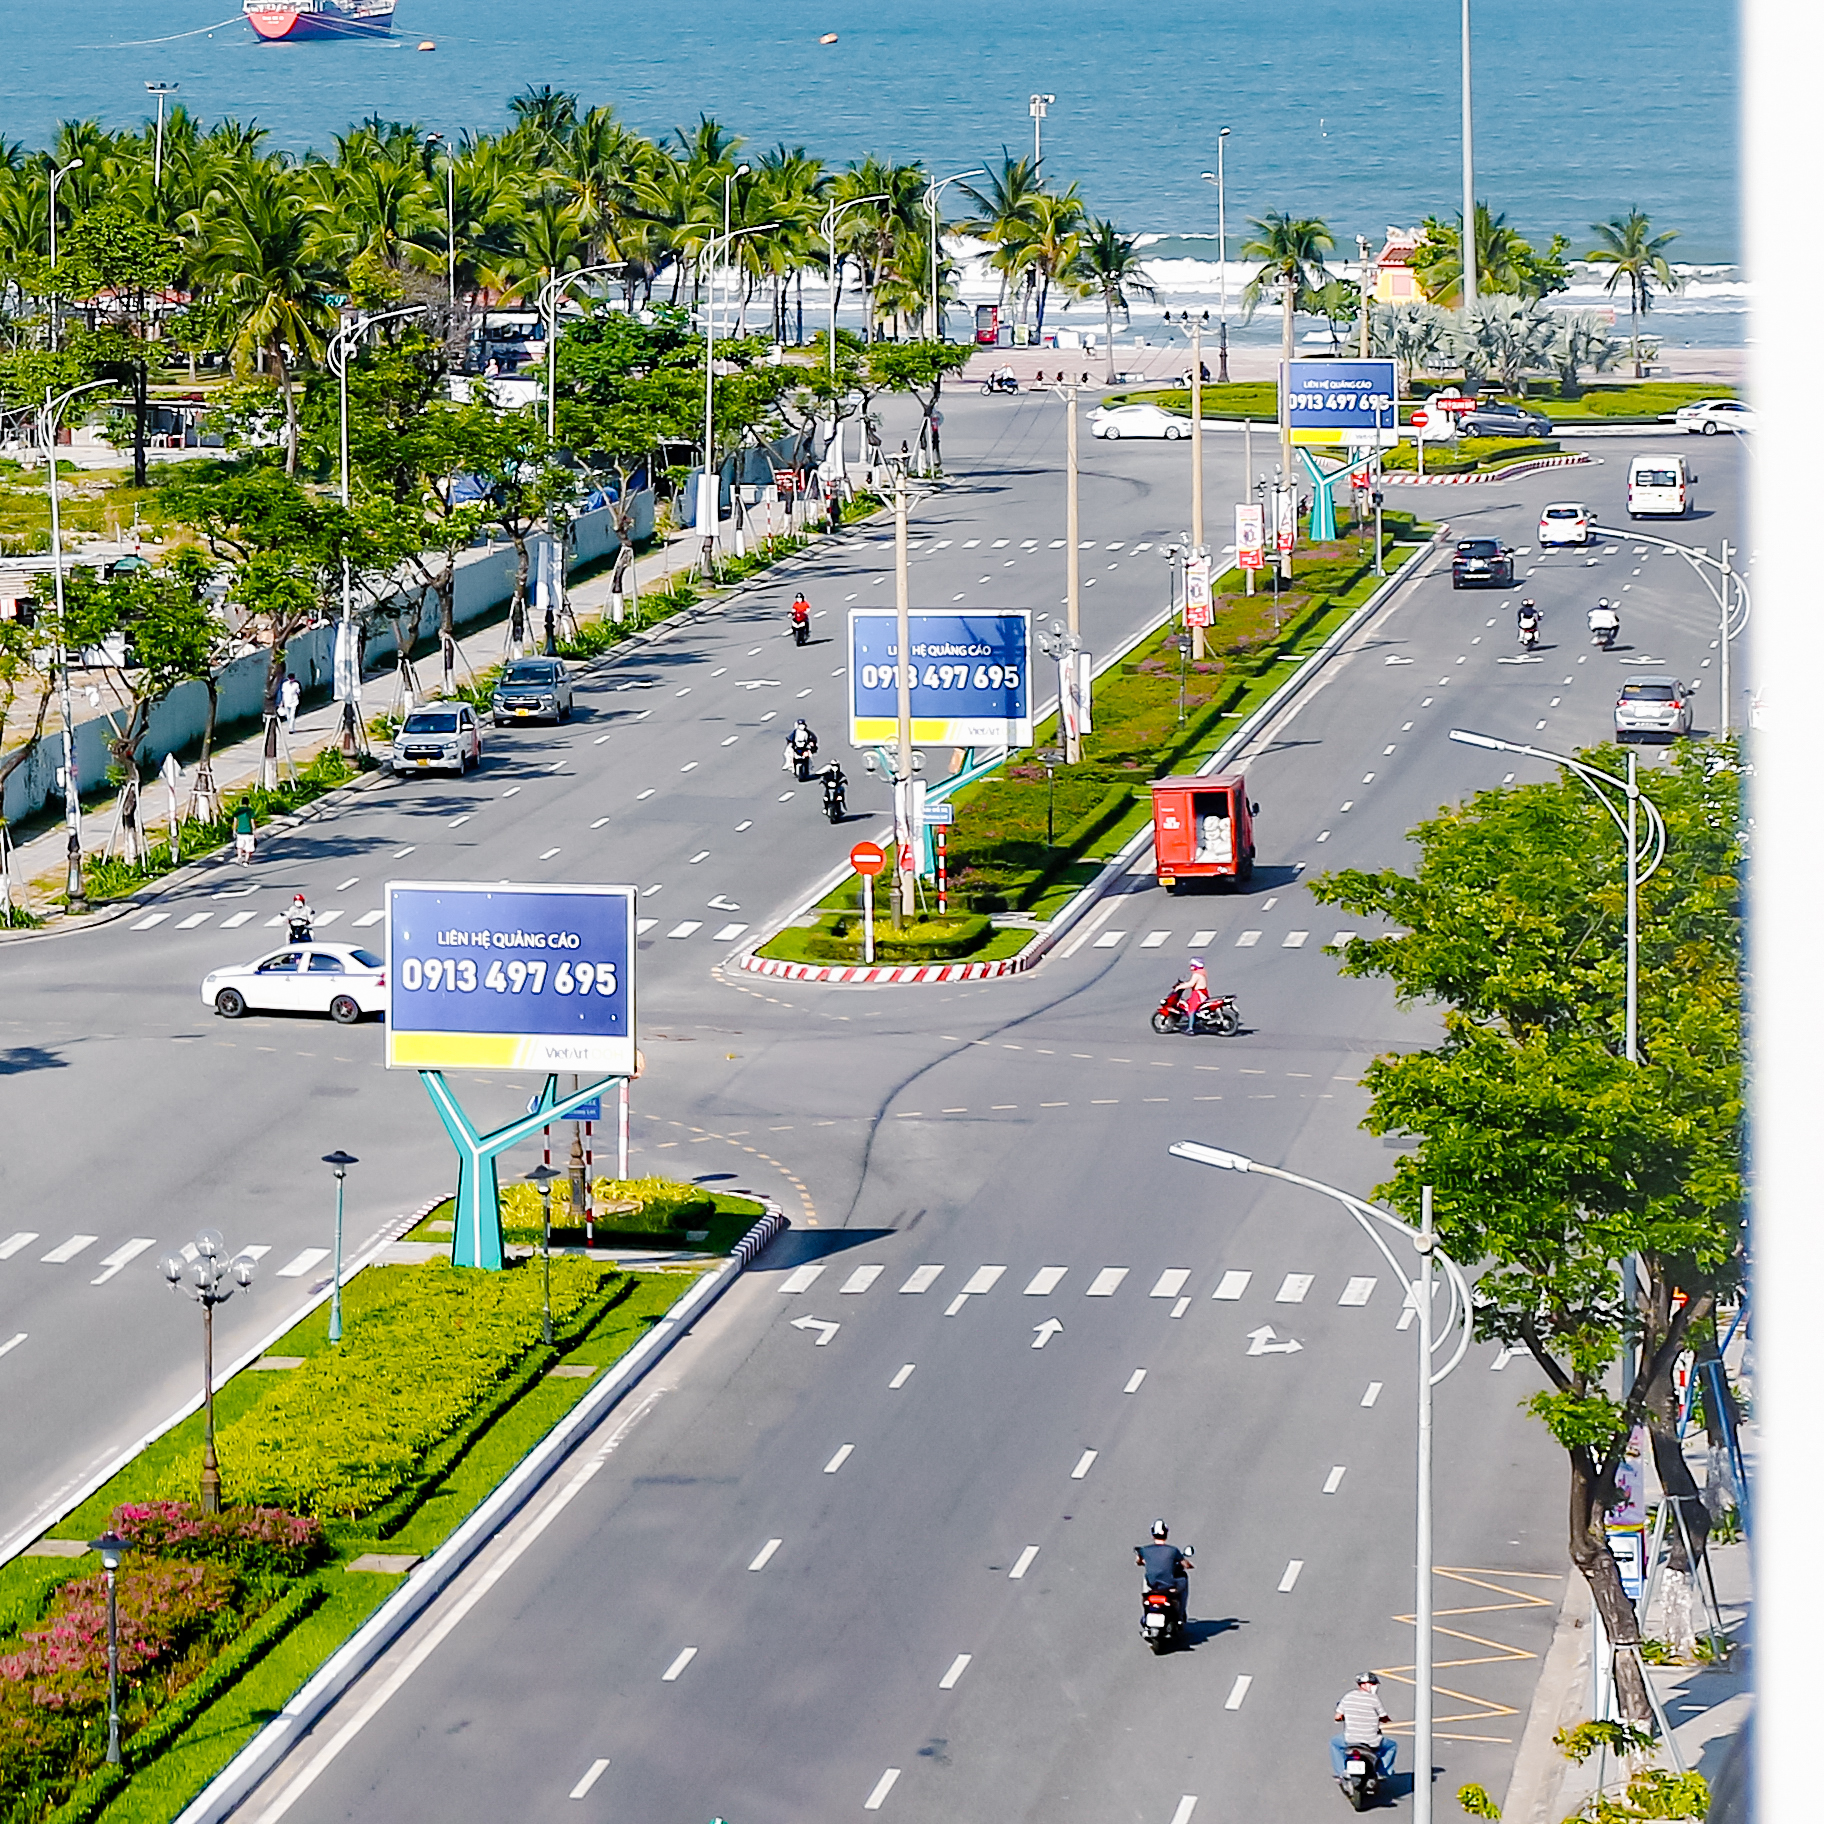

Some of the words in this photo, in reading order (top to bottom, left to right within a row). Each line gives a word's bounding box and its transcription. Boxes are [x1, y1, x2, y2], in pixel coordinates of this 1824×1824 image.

[1289, 393, 1324, 411] 0913
[1325, 393, 1358, 411] 497
[911, 642, 927, 658] HỆ
[927, 641, 968, 657] QUẢNG
[967, 643, 992, 657] CÁO
[922, 663, 970, 691] 497
[973, 664, 1020, 691] 695
[437, 928, 469, 947] LIÊN
[471, 928, 491, 950] HỆ
[492, 928, 546, 949] QUẢNG
[548, 930, 581, 950] CÁO
[401, 956, 478, 992] 0913
[484, 959, 548, 995] 497
[554, 961, 618, 996] 695
[545, 1045, 589, 1061] VietArt
